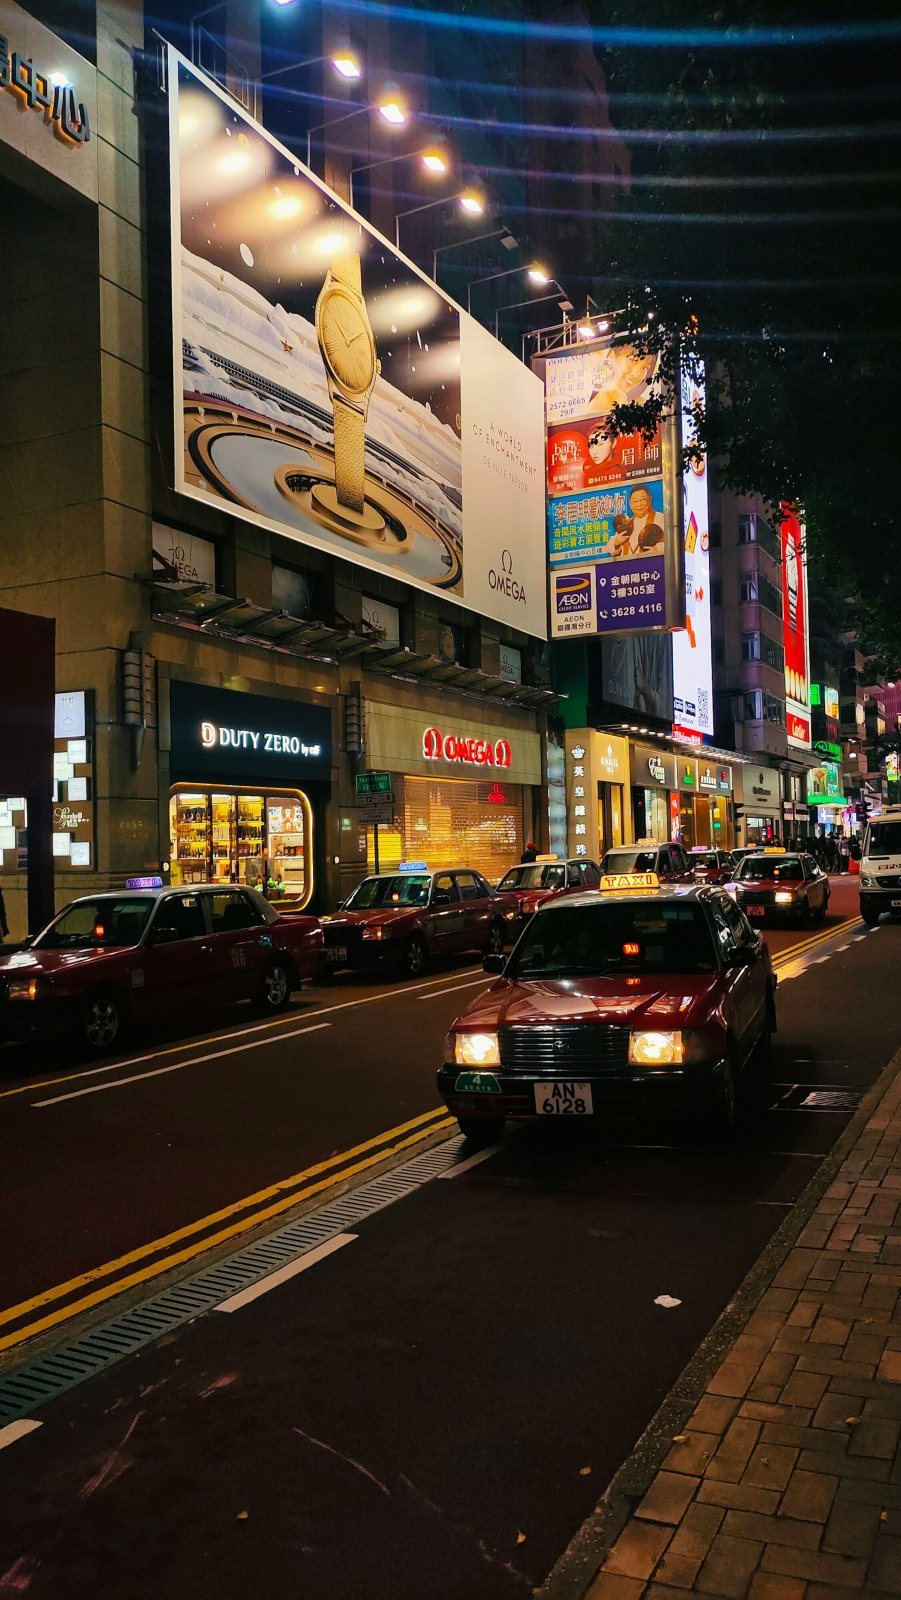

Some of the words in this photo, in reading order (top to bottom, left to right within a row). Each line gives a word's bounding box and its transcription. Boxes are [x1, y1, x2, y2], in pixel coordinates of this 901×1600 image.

[550, 400, 567, 411] 2572
[490, 421, 495, 432] A
[498, 426, 521, 452] WORLD
[472, 424, 483, 437] OF
[486, 433, 537, 479] ENCHANTMENT
[493, 463, 507, 480] VILLE
[610, 571, 661, 586] 金朝陽中心
[488, 569, 527, 605] OMEGA
[611, 606, 636, 617] 3628
[638, 603, 662, 613] 4116
[219, 727, 260, 749] DUTY
[264, 733, 300, 754] ZERO
[443, 735, 494, 766] OMEGA
[127, 878, 156, 887] TAXI
[605, 874, 653, 887] TAXI
[624, 944, 639, 954] TAXI
[473, 1075, 481, 1084] 4
[551, 1083, 576, 1099] AN
[542, 1098, 587, 1113] 6128
